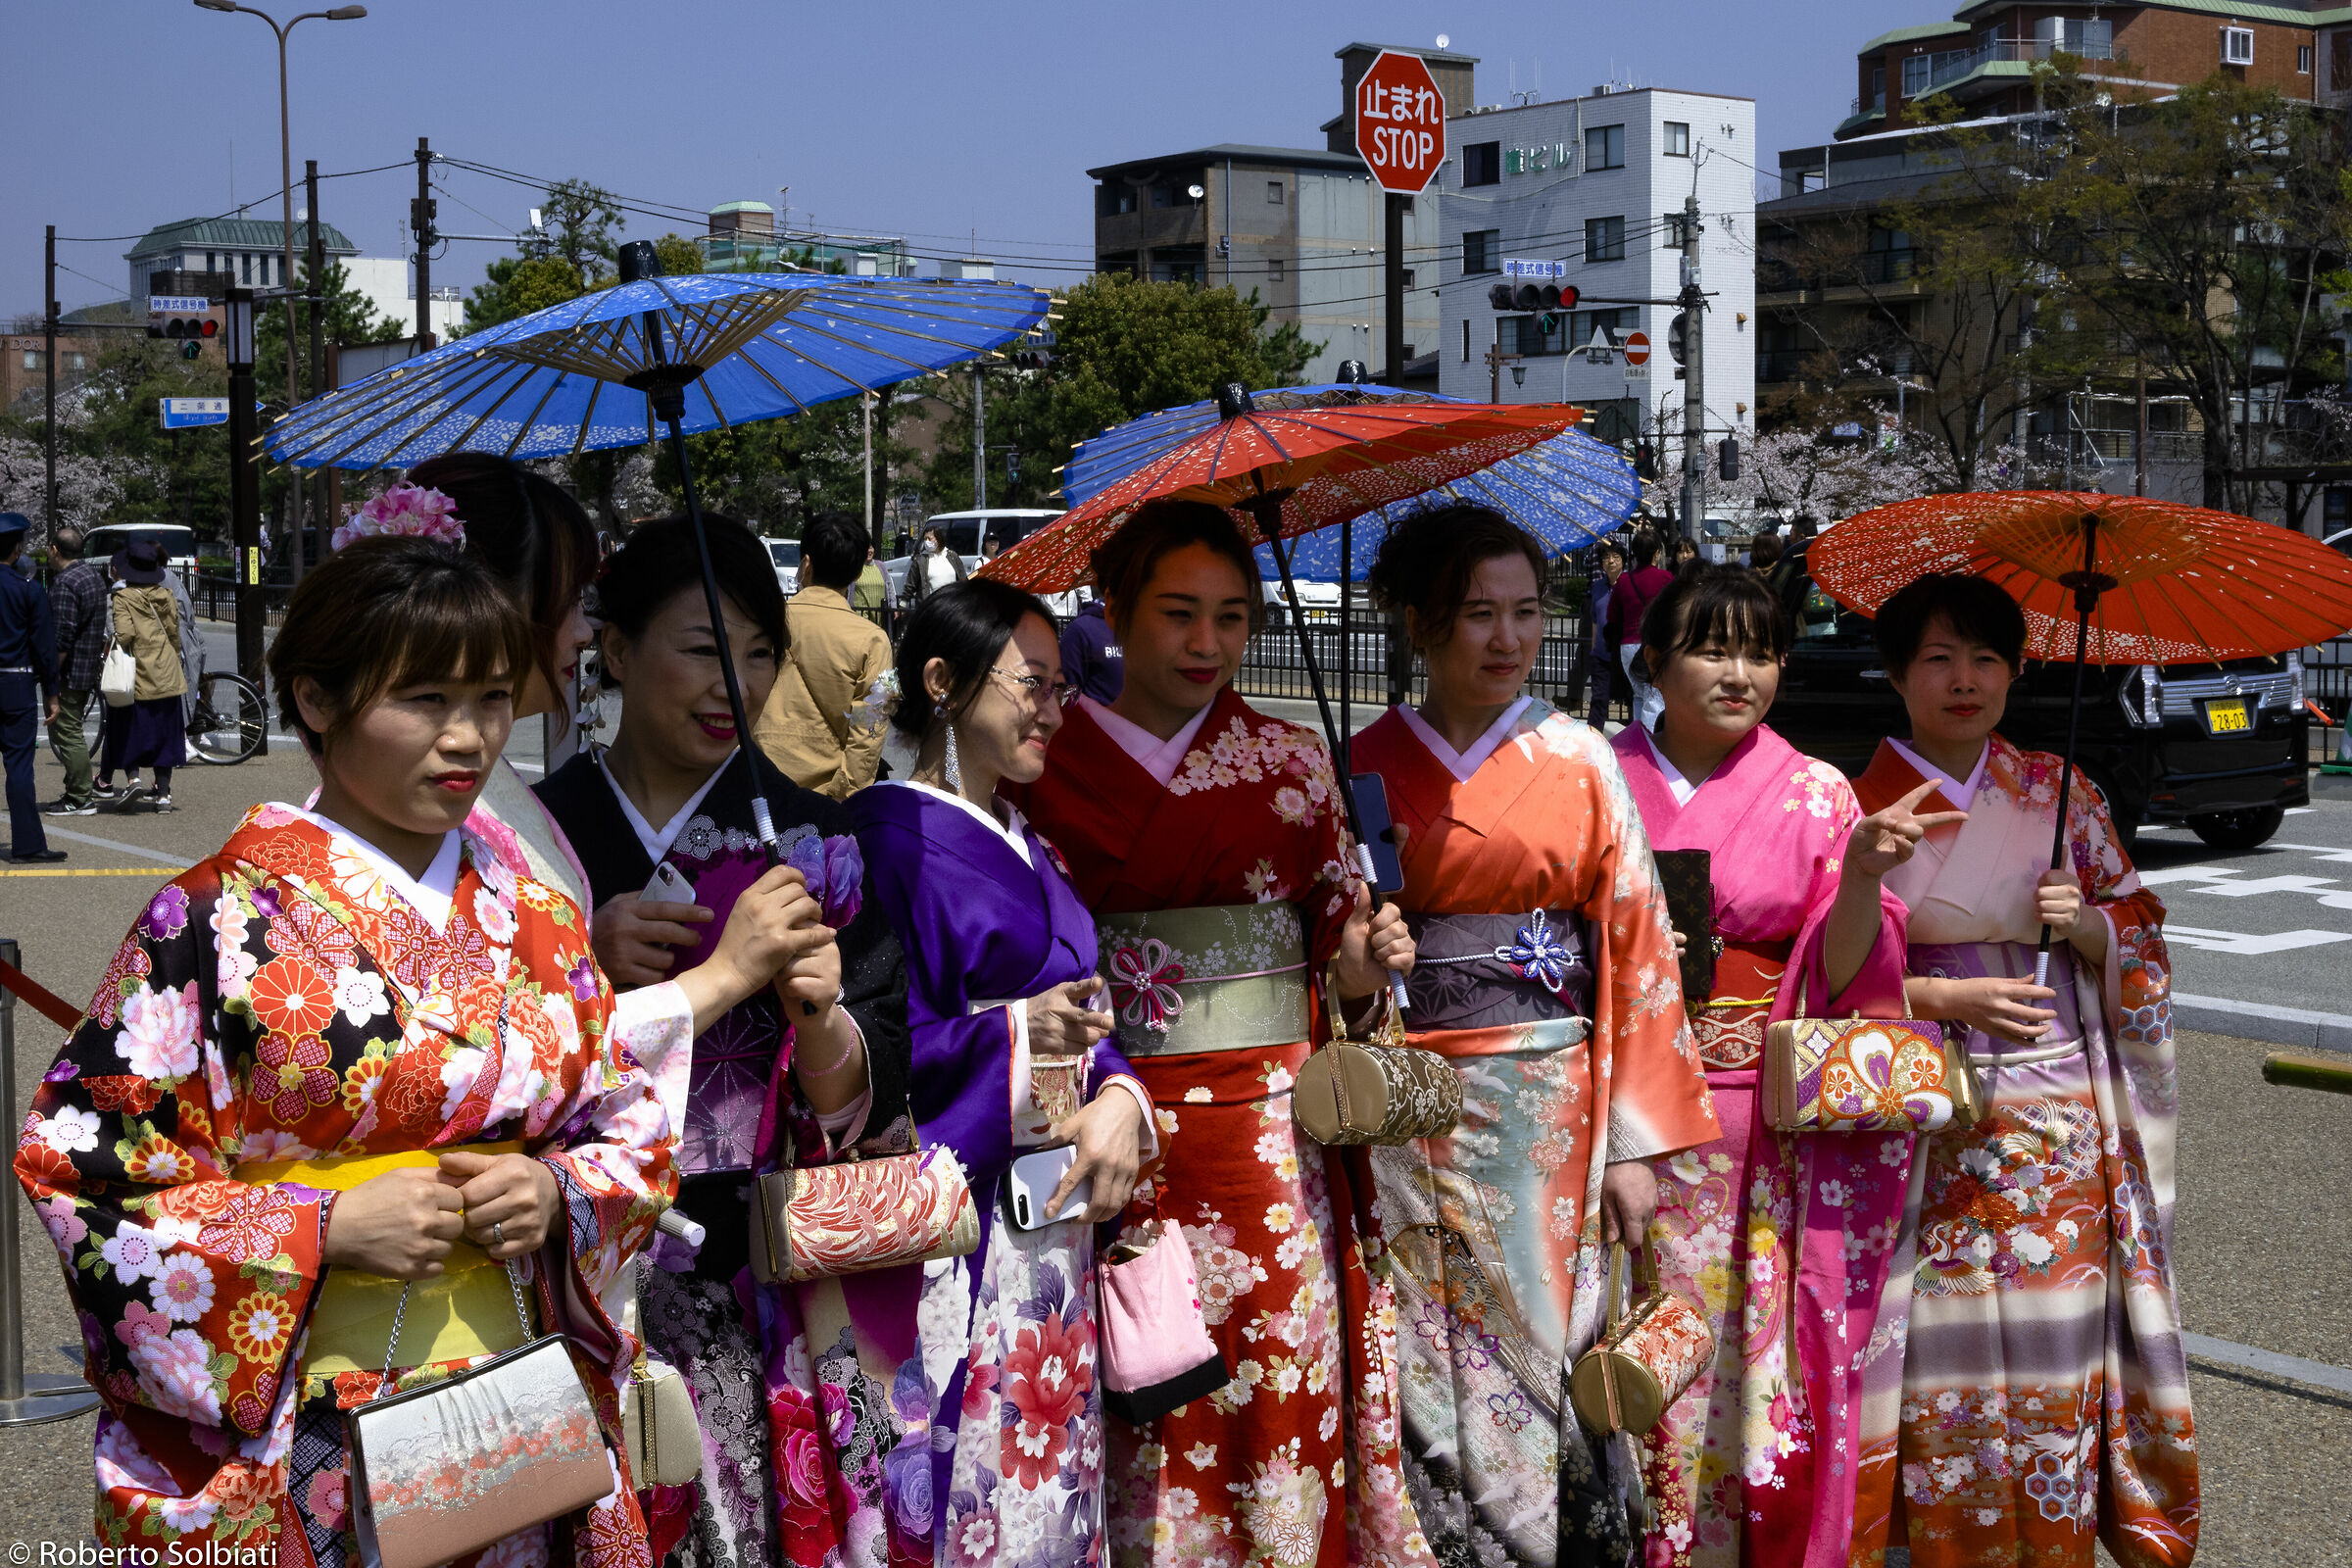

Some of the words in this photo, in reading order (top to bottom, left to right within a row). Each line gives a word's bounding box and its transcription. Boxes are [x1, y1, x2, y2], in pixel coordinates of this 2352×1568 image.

[1363, 78, 1440, 125] 止まれ
[1372, 125, 1434, 171] STOP
[1505, 143, 1570, 173] ビル
[153, 299, 207, 311] 時差式信号機
